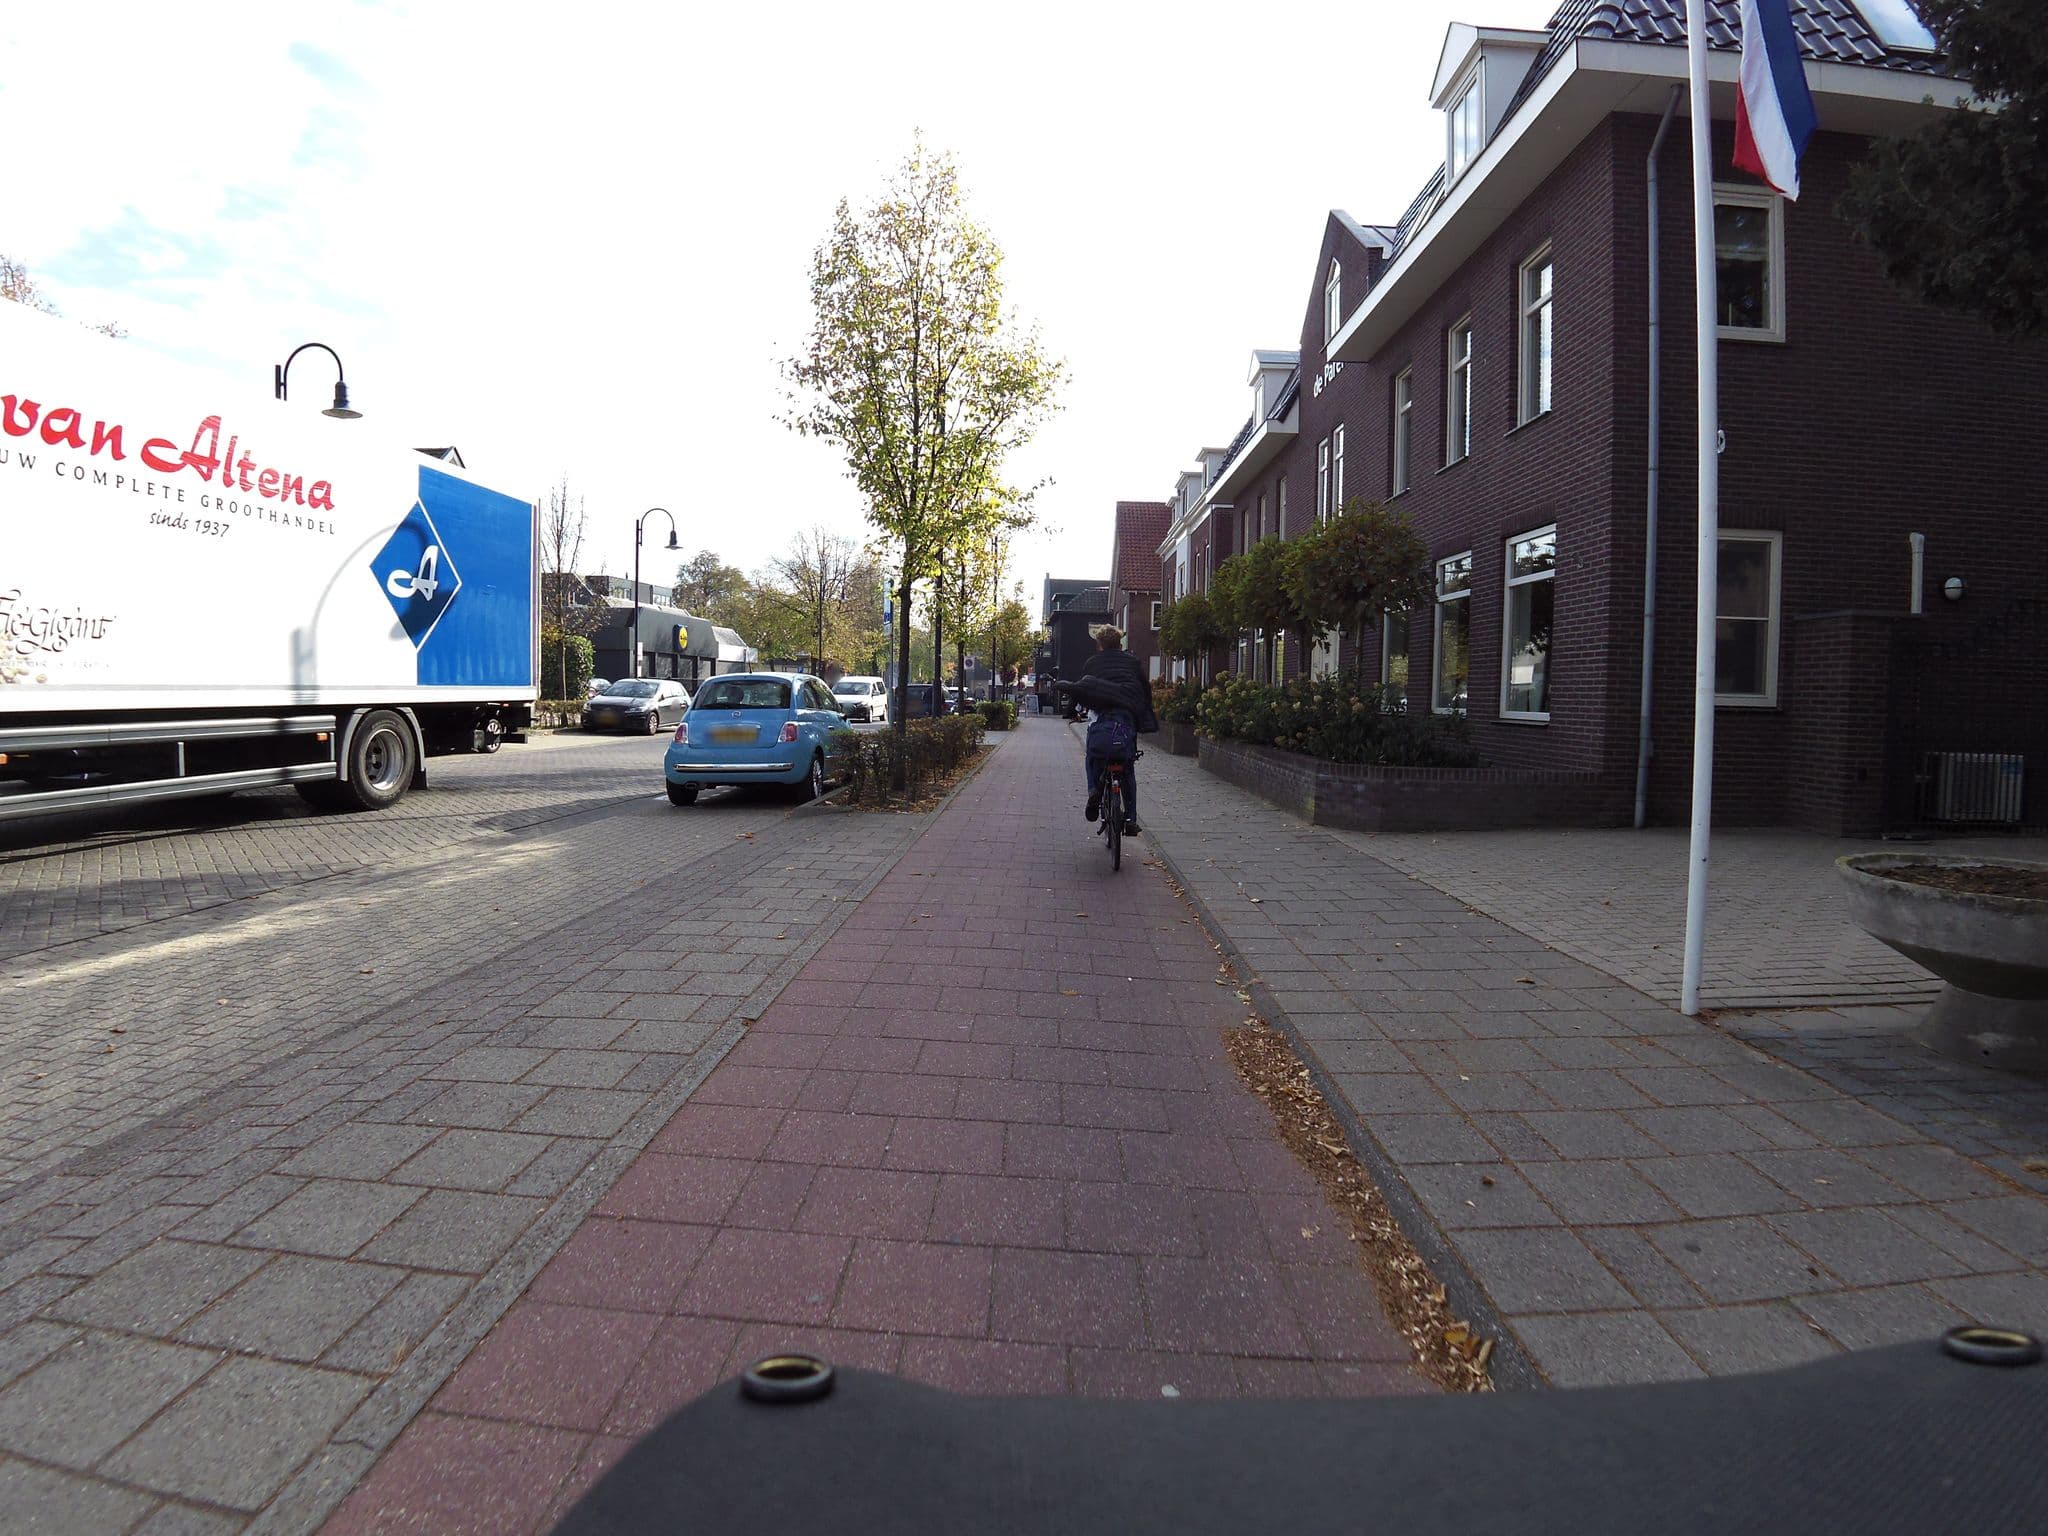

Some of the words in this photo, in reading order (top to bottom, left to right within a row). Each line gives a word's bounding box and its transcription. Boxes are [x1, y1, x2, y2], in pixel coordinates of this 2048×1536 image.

[1313, 374, 1323, 398] de
[1324, 361, 1344, 387] Pare
[1, 394, 127, 461] van
[140, 415, 335, 511] Altena
[56, 462, 185, 502] COMPLETE
[201, 495, 334, 535] GROOTHANDEL
[150, 509, 189, 530] sinds
[195, 519, 230, 537] 1937
